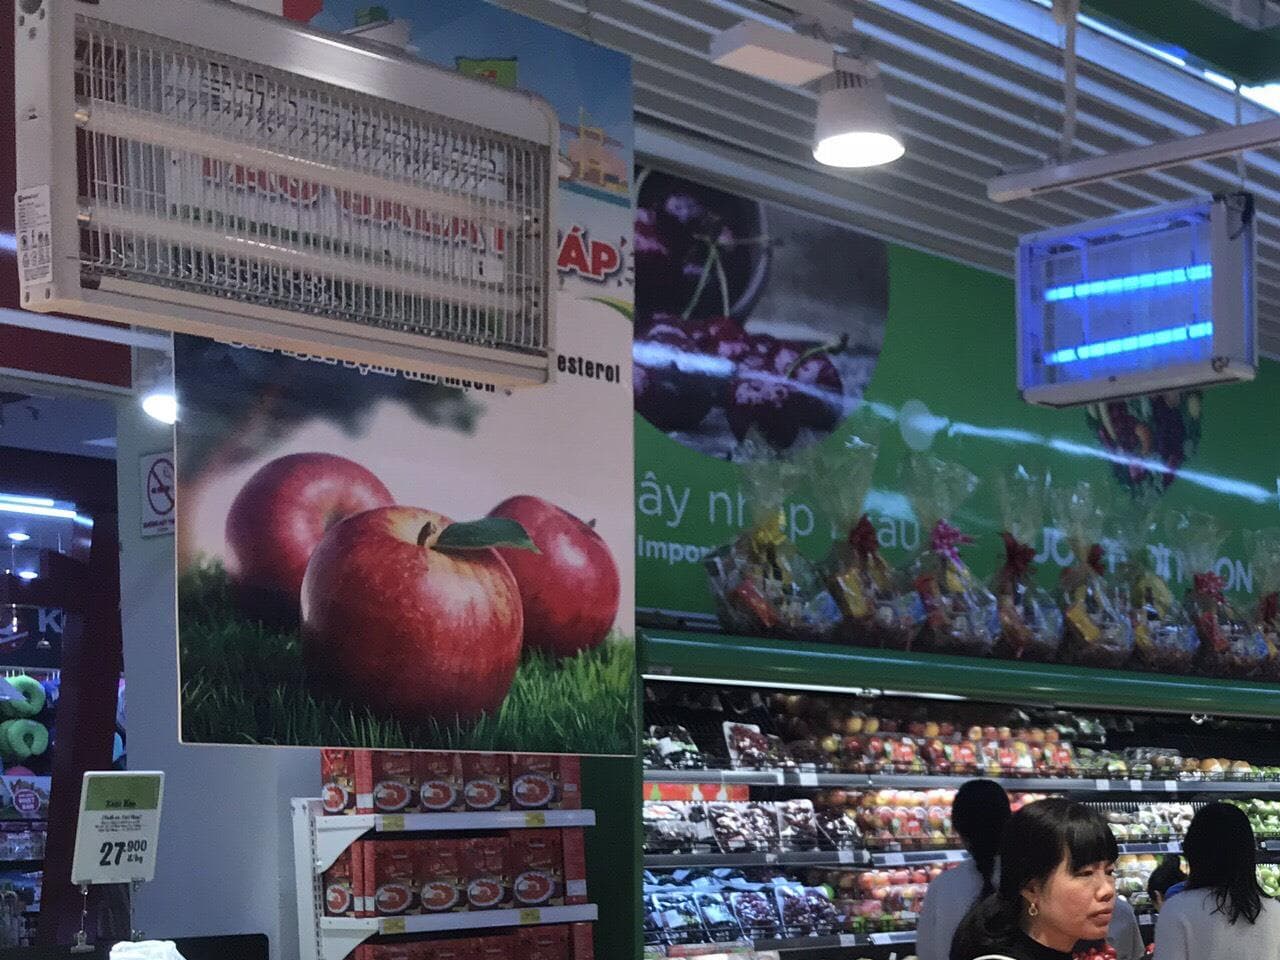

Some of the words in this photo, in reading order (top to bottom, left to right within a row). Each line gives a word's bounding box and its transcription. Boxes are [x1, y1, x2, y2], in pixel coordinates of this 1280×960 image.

[556, 225, 620, 277] ÁP
[557, 353, 620, 384] esterol
[638, 470, 691, 528] ây
[638, 534, 716, 564] Impor
